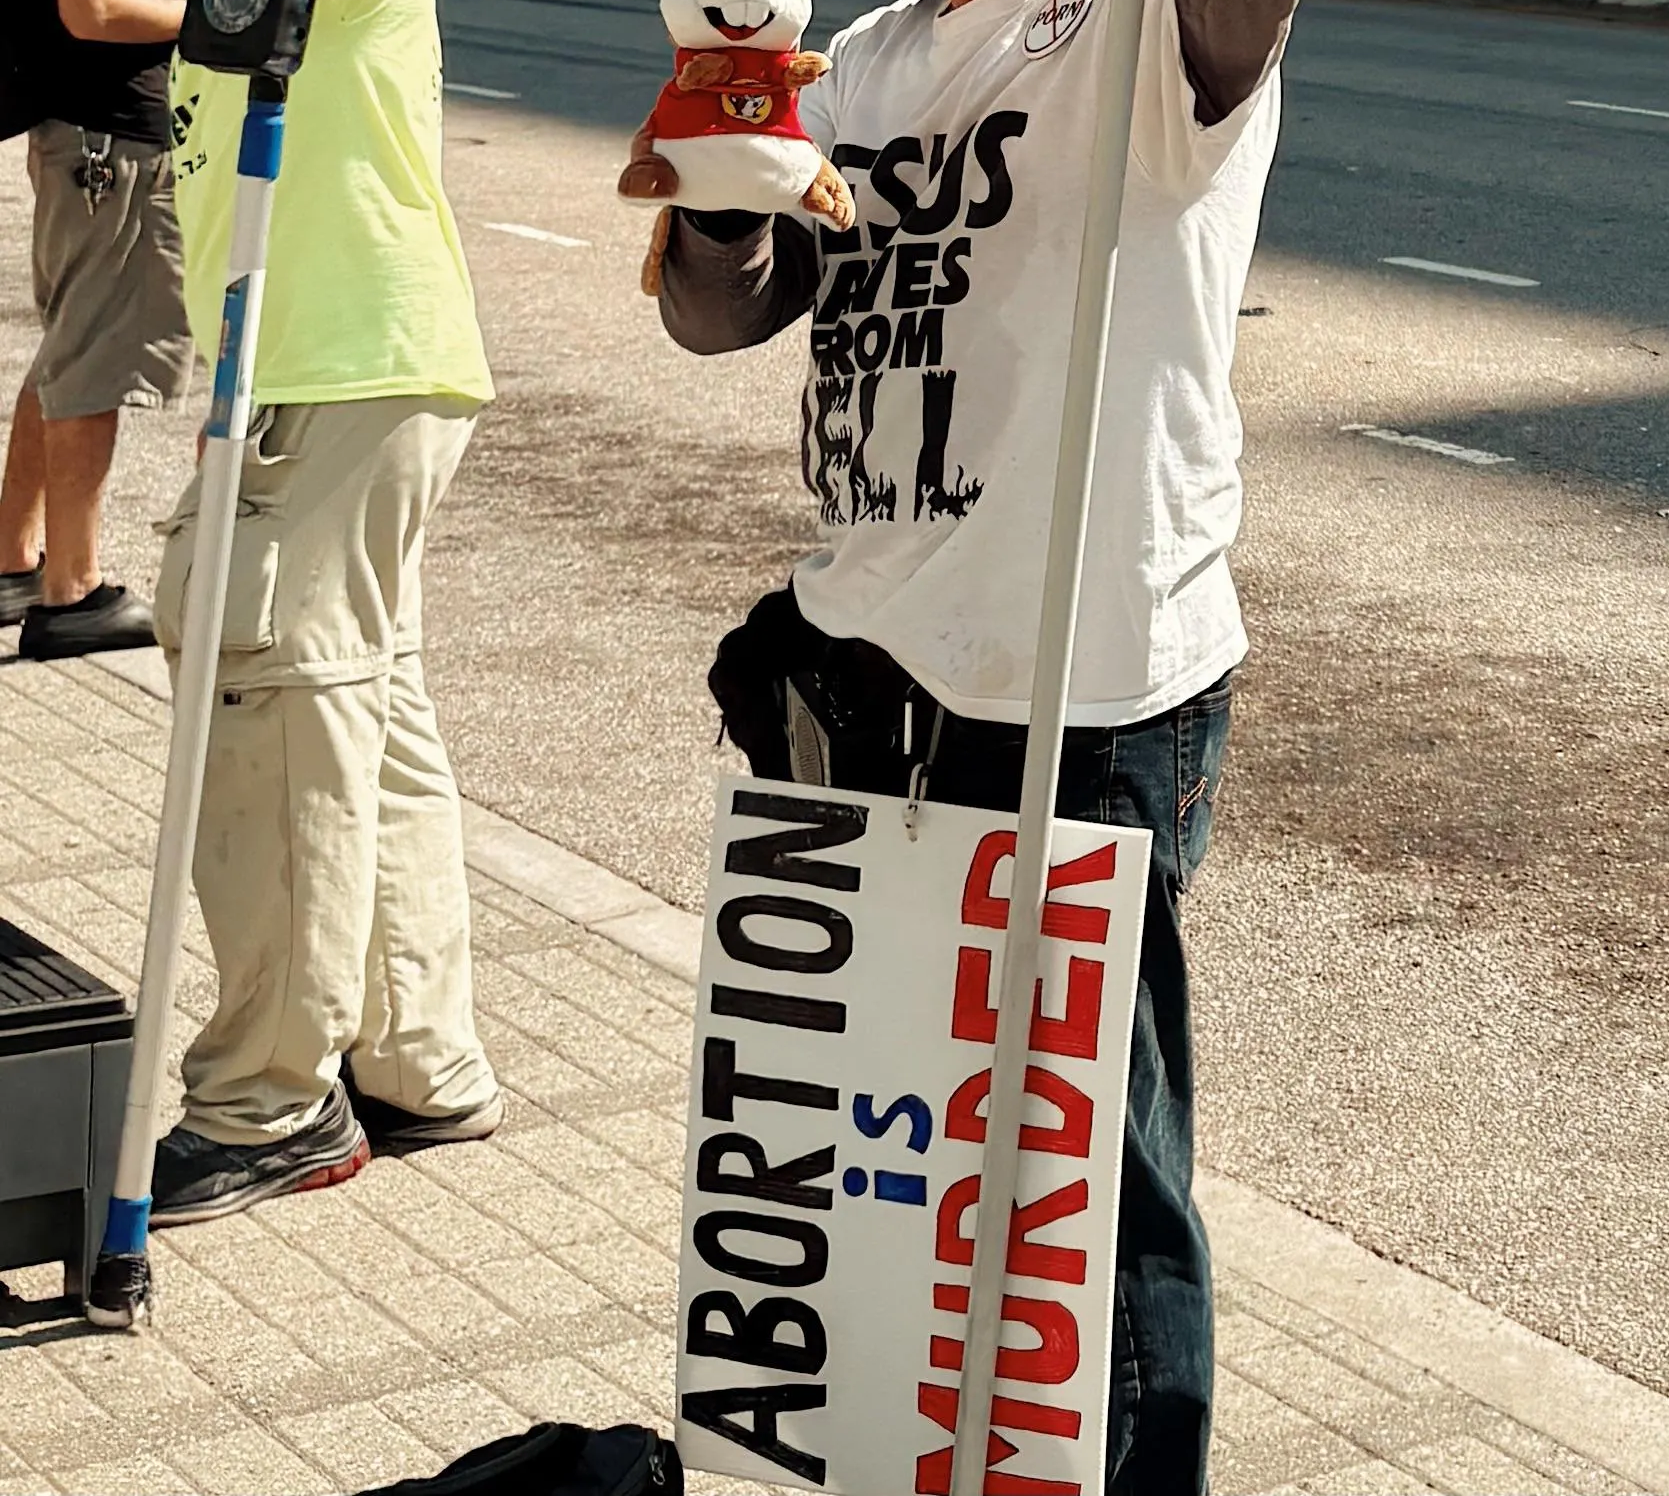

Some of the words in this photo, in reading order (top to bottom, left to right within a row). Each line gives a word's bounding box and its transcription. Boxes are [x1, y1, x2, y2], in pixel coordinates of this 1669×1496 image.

[1031, 0, 1084, 30] PORN
[820, 110, 1029, 255] ESUS
[815, 237, 972, 325] AVES
[680, 789, 870, 1487] ABORTION
[915, 829, 1118, 1496] MURDER
